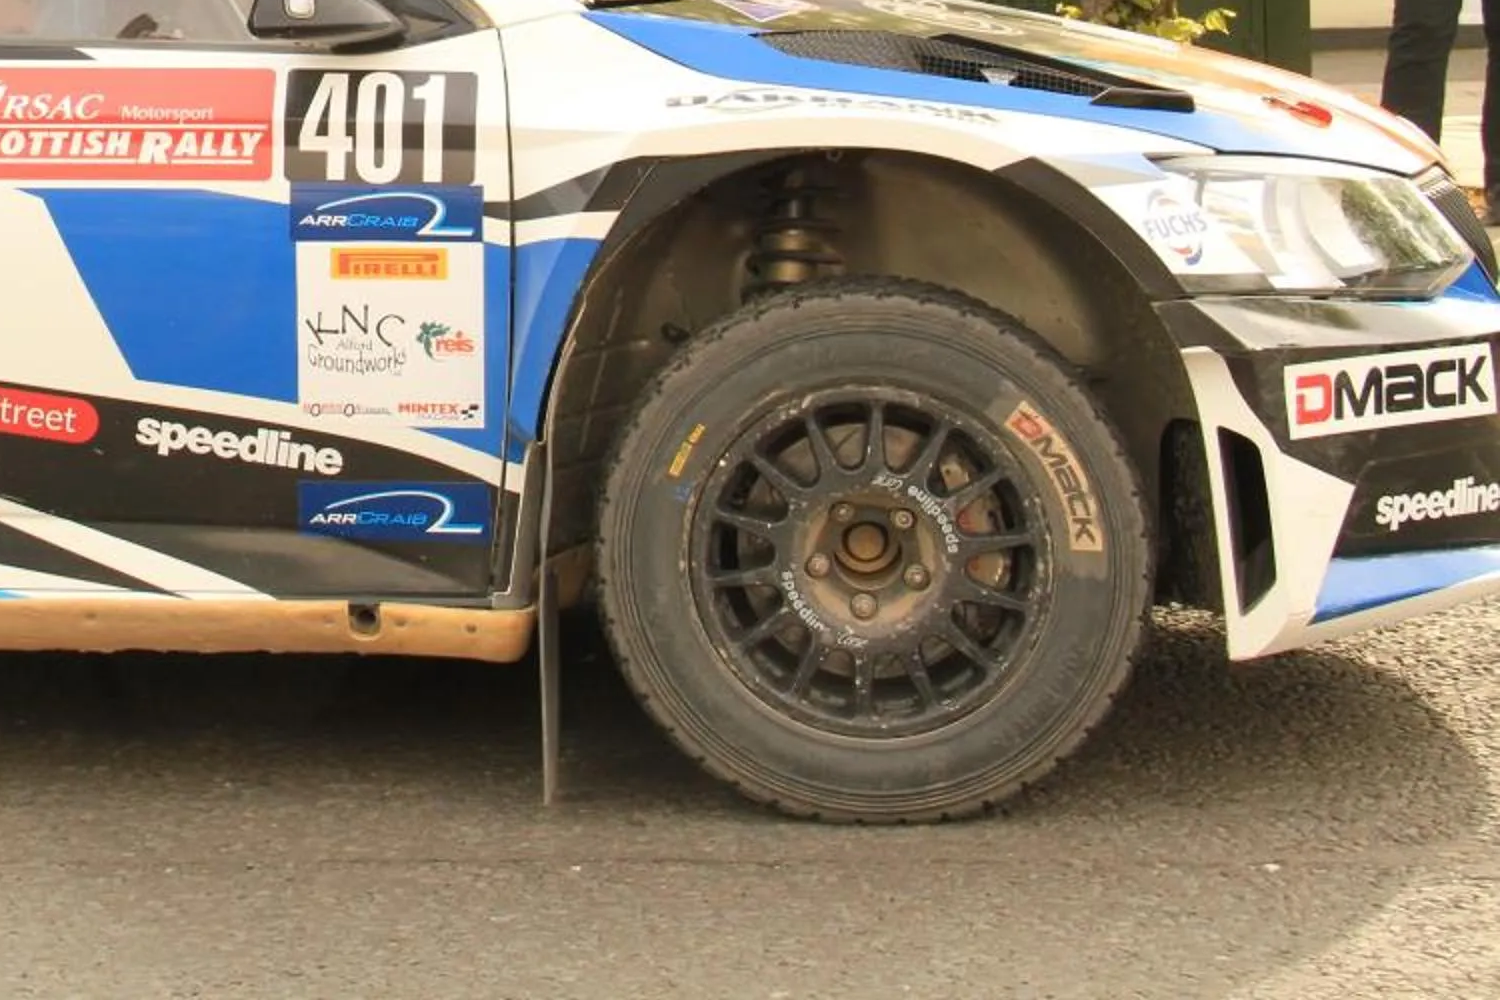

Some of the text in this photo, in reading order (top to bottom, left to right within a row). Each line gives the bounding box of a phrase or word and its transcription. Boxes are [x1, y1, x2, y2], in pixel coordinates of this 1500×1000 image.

[1, 93, 215, 125] RSAC Motorsport
[299, 70, 447, 185] 401
[137, 131, 264, 165] RALLY
[1143, 211, 1208, 241] FUCHS
[338, 252, 438, 277] PIRELLI
[305, 303, 405, 347] KNC
[435, 330, 475, 353] reis
[398, 403, 459, 415] MINTEX
[1296, 356, 1489, 426] DMACK
[135, 416, 343, 476] speedline
[1011, 410, 1097, 545] DMACK
[1375, 476, 1500, 531] speedline
